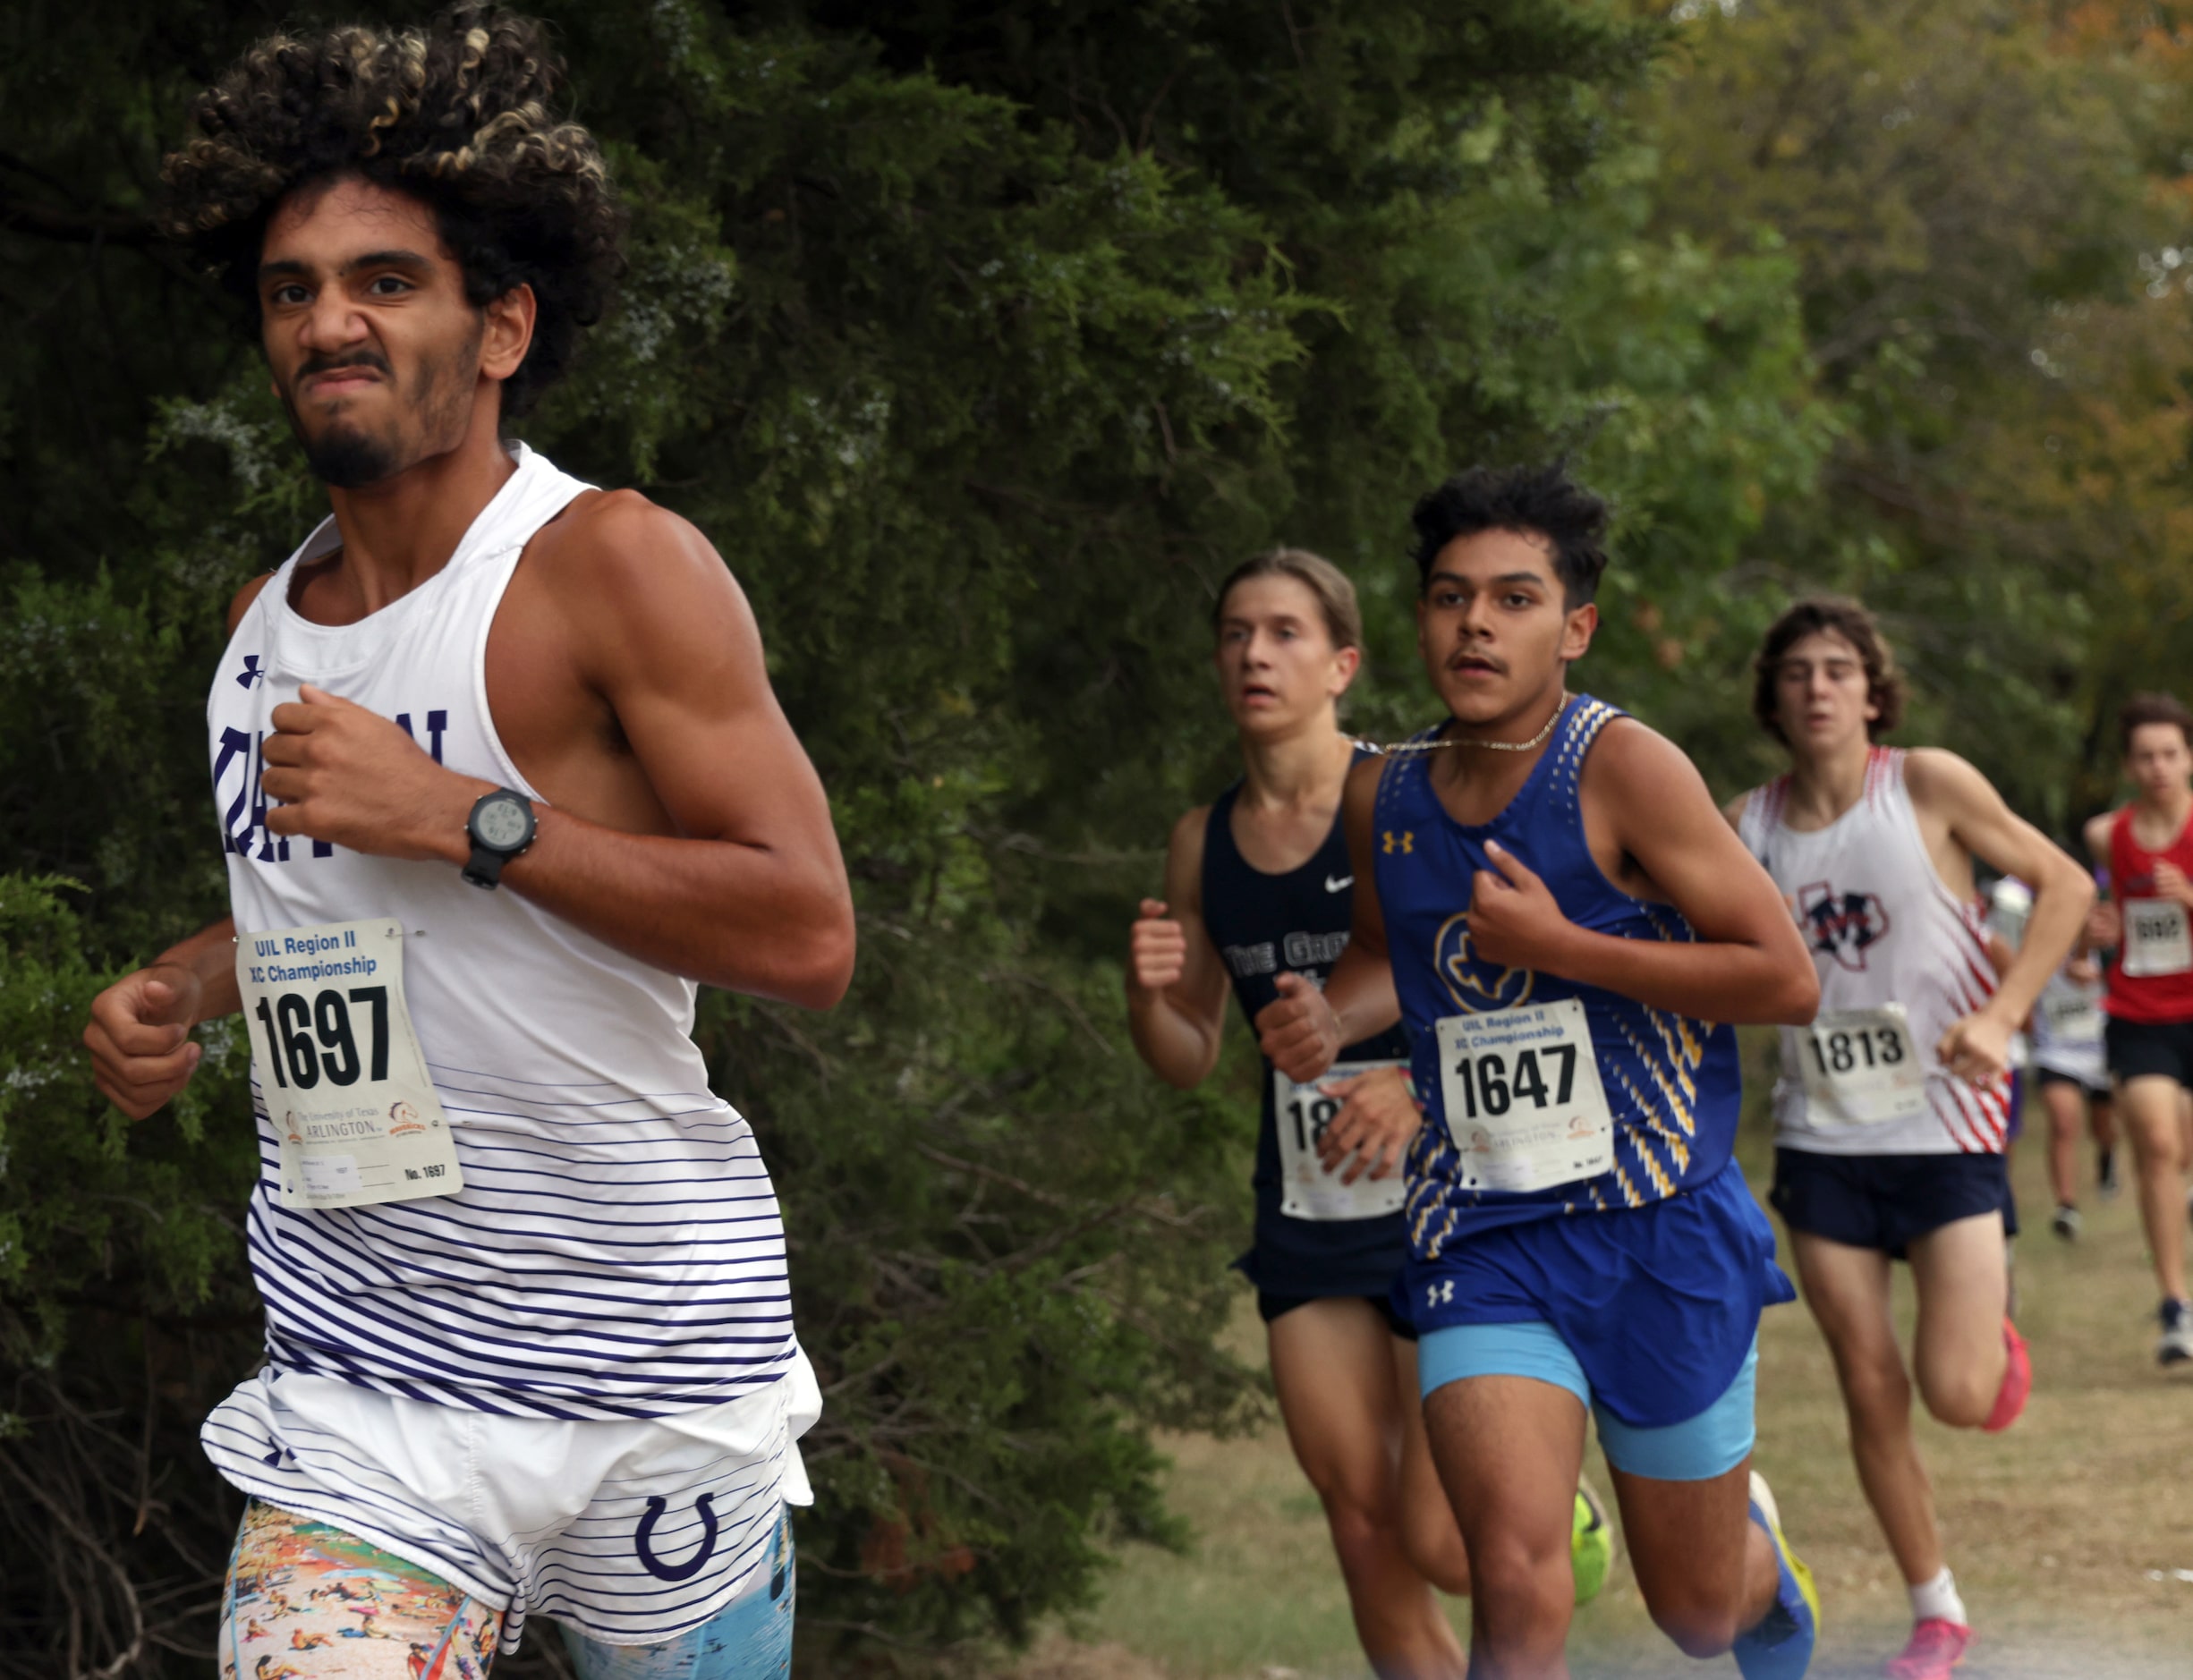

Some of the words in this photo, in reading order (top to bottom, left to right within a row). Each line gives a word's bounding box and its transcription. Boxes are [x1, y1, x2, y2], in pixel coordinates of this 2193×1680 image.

[255, 939, 280, 958] UIL
[285, 935, 340, 956] Region
[344, 930, 356, 948] II
[249, 966, 266, 983] XC
[268, 955, 377, 981] Championship
[1462, 1019, 1483, 1032] UIL
[1486, 1014, 1531, 1030] Region
[1472, 1024, 1565, 1048] Championship
[255, 986, 389, 1090] 1697
[1808, 1028, 1903, 1076] 1813
[1456, 1043, 1577, 1118] 1647
[355, 1107, 379, 1117] Texas
[306, 1120, 375, 1138] ARLINGTON
[404, 1168, 421, 1181] No.
[422, 1164, 446, 1178] 1697
